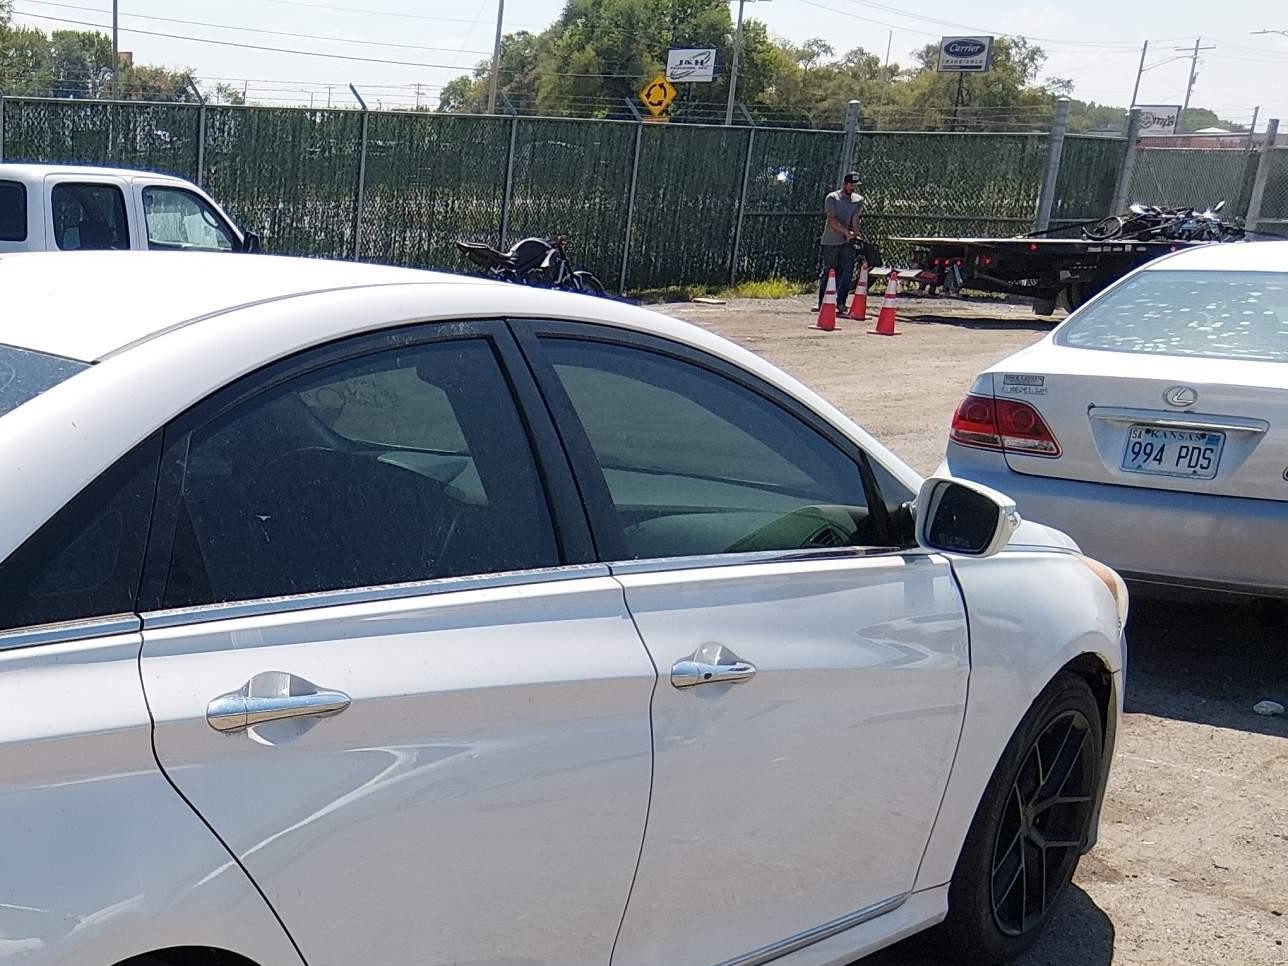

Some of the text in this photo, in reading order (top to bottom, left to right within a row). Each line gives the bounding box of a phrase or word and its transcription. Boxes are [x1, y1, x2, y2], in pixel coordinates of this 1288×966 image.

[949, 43, 981, 52] Carrier
[1151, 430, 1202, 441] KANSAS
[1130, 441, 1214, 470] 994 PDS
